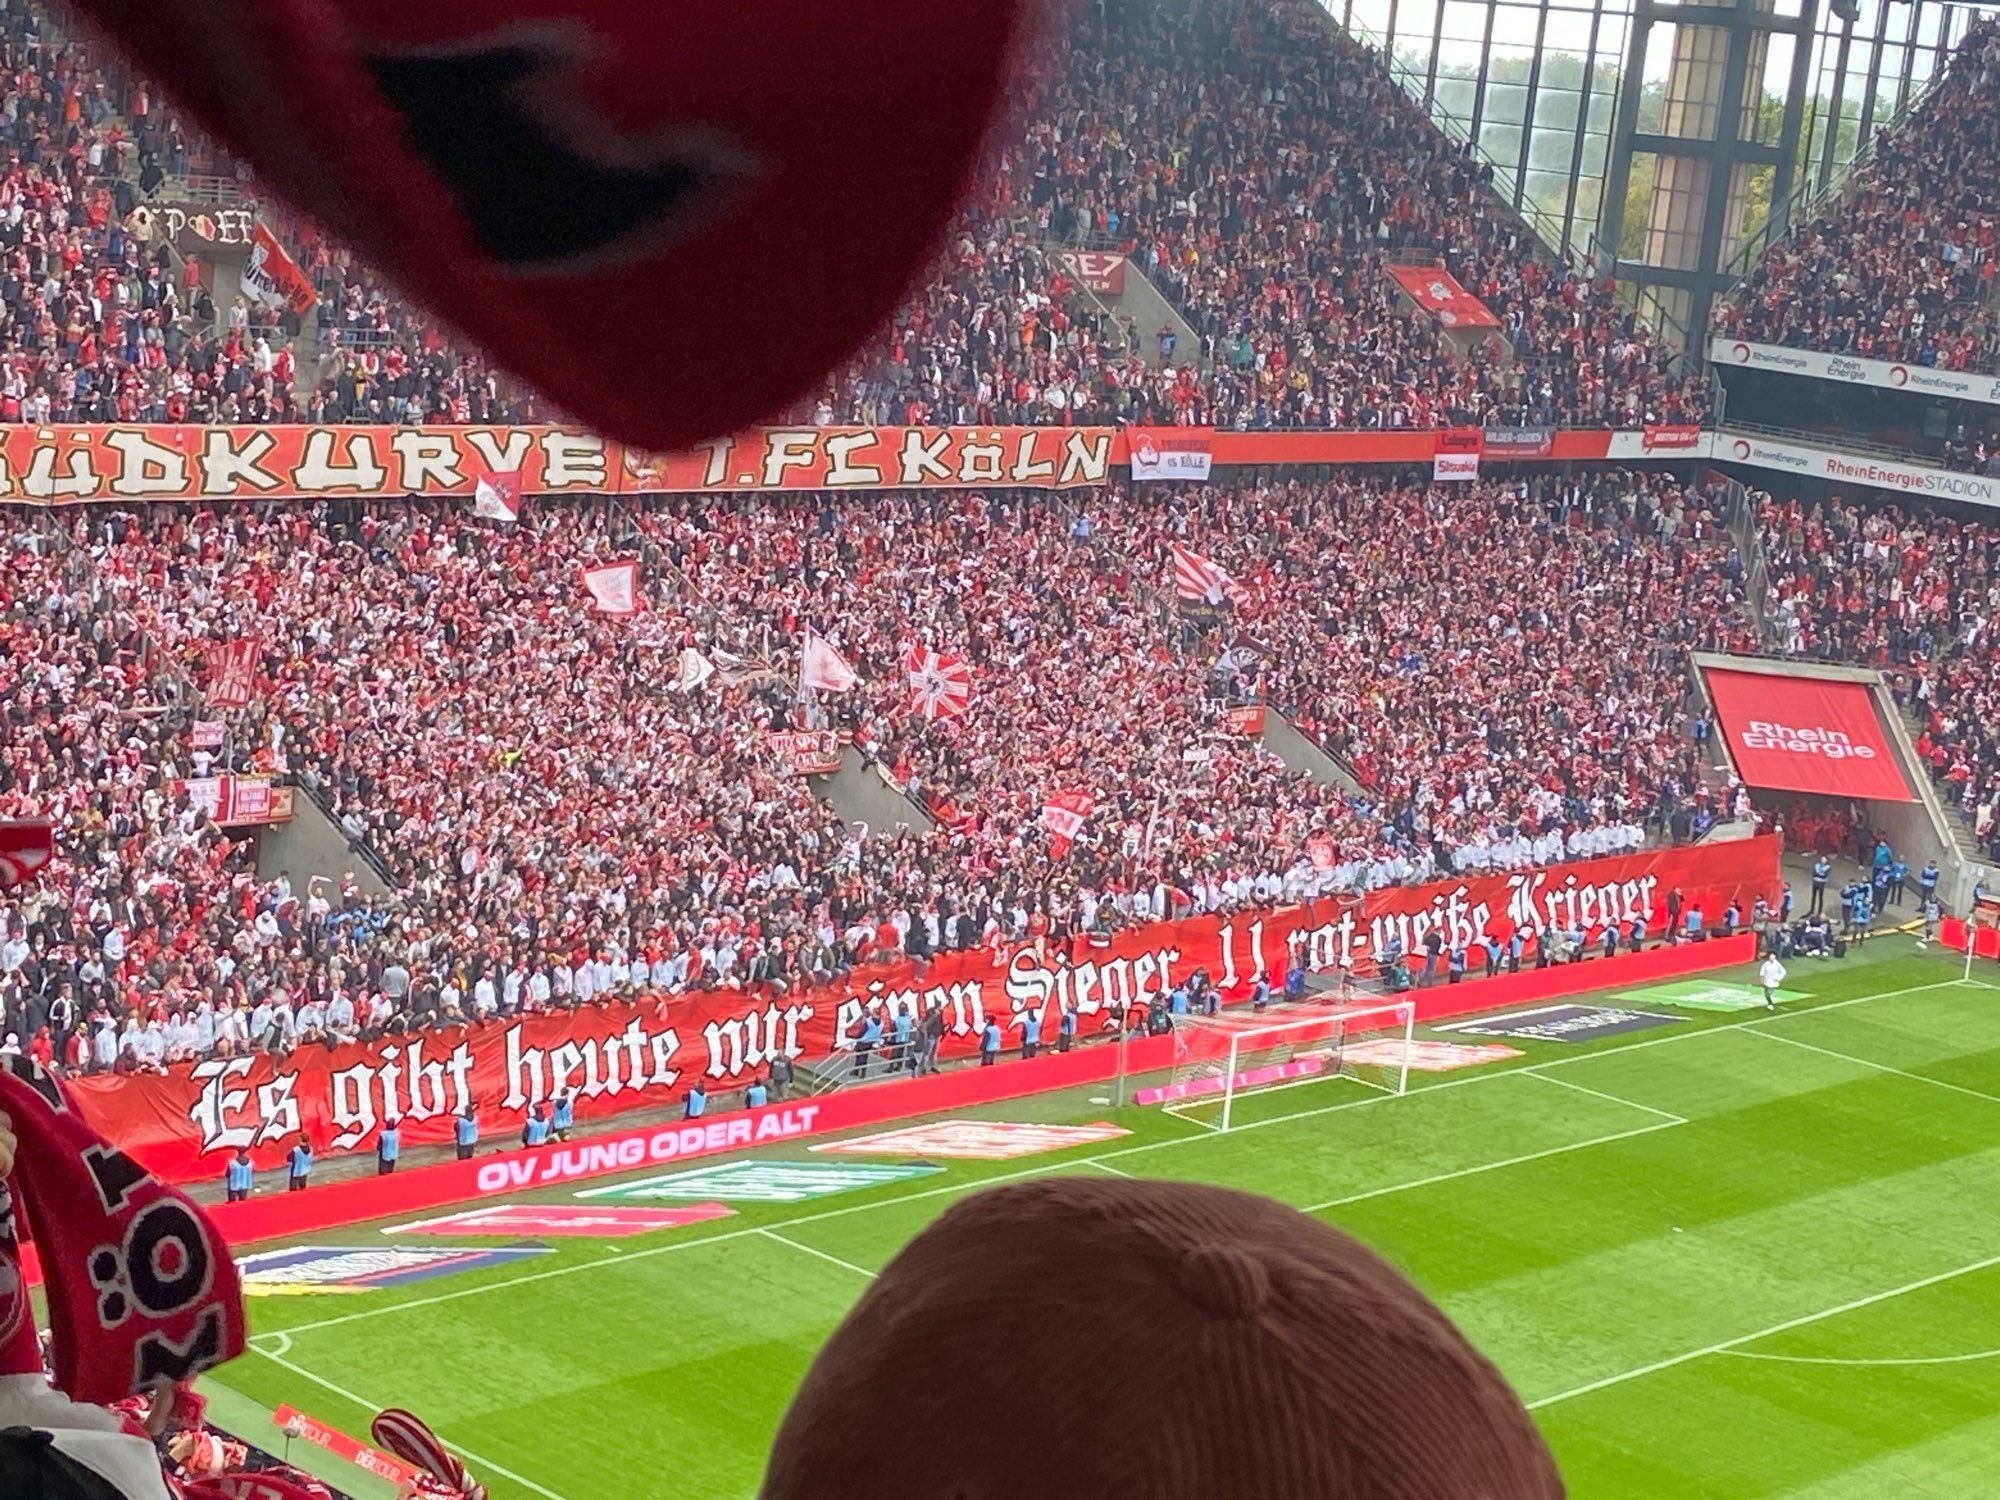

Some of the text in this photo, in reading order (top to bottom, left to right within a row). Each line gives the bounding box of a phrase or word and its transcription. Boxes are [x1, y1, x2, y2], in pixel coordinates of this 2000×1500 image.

[1752, 351, 1807, 368] RheinEnergie
[1831, 357, 1861, 371] Rhein
[1827, 365, 1866, 381] Energie
[0, 424, 606, 498] ÜDKURVE
[899, 430, 1109, 485] KÖLN
[1752, 449, 1808, 466] RheinEnergie
[1749, 720, 1849, 744] Rhein
[1742, 732, 1876, 758] Energie
[190, 1056, 301, 1156] Es
[330, 1038, 476, 1150] gibt
[500, 1014, 683, 1118] heute
[703, 1002, 815, 1080] nur
[1005, 945, 1181, 1031] Sieger
[477, 1158, 537, 1192] OV
[541, 1137, 647, 1180] JUNG
[650, 1117, 753, 1159] ODER
[754, 1106, 820, 1140] ALT
